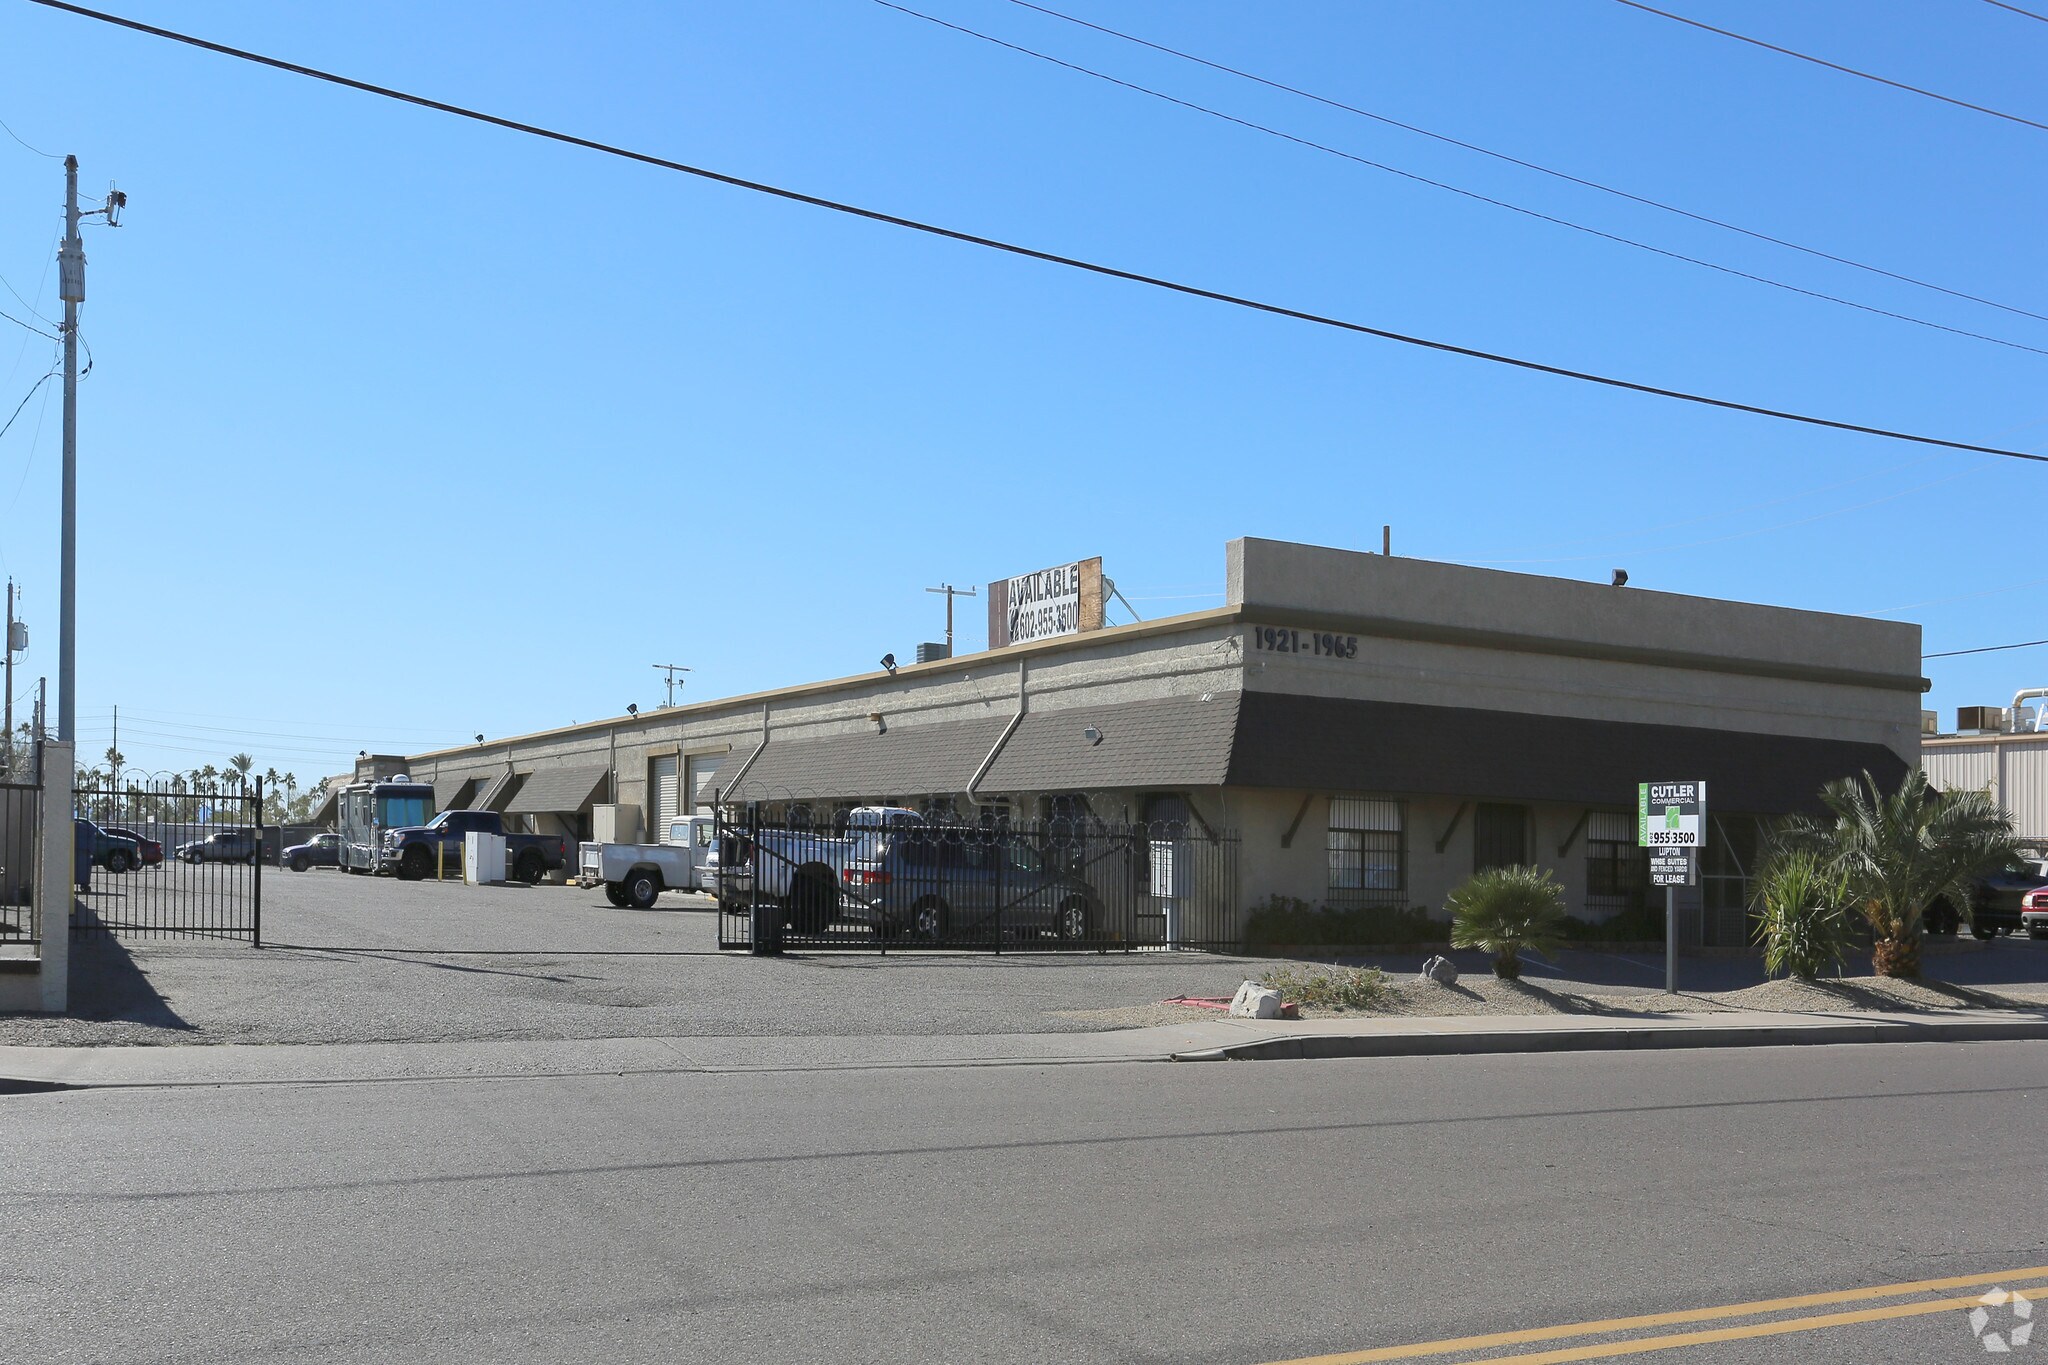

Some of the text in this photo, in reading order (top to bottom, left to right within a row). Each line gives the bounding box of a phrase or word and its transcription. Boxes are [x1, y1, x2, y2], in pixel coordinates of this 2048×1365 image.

[1008, 565, 1078, 608] AVAILABLE
[1020, 601, 1077, 640] 602-955-3500
[1651, 785, 1694, 798] CUTLER
[1639, 788, 1647, 843] AVAILABLE
[1658, 847, 1681, 856] LUPTON
[1667, 858, 1688, 866] SUITES
[1658, 865, 1674, 873] FENCED
[1674, 865, 1688, 873] YARDS
[1653, 874, 1685, 884] FOR LEASE
